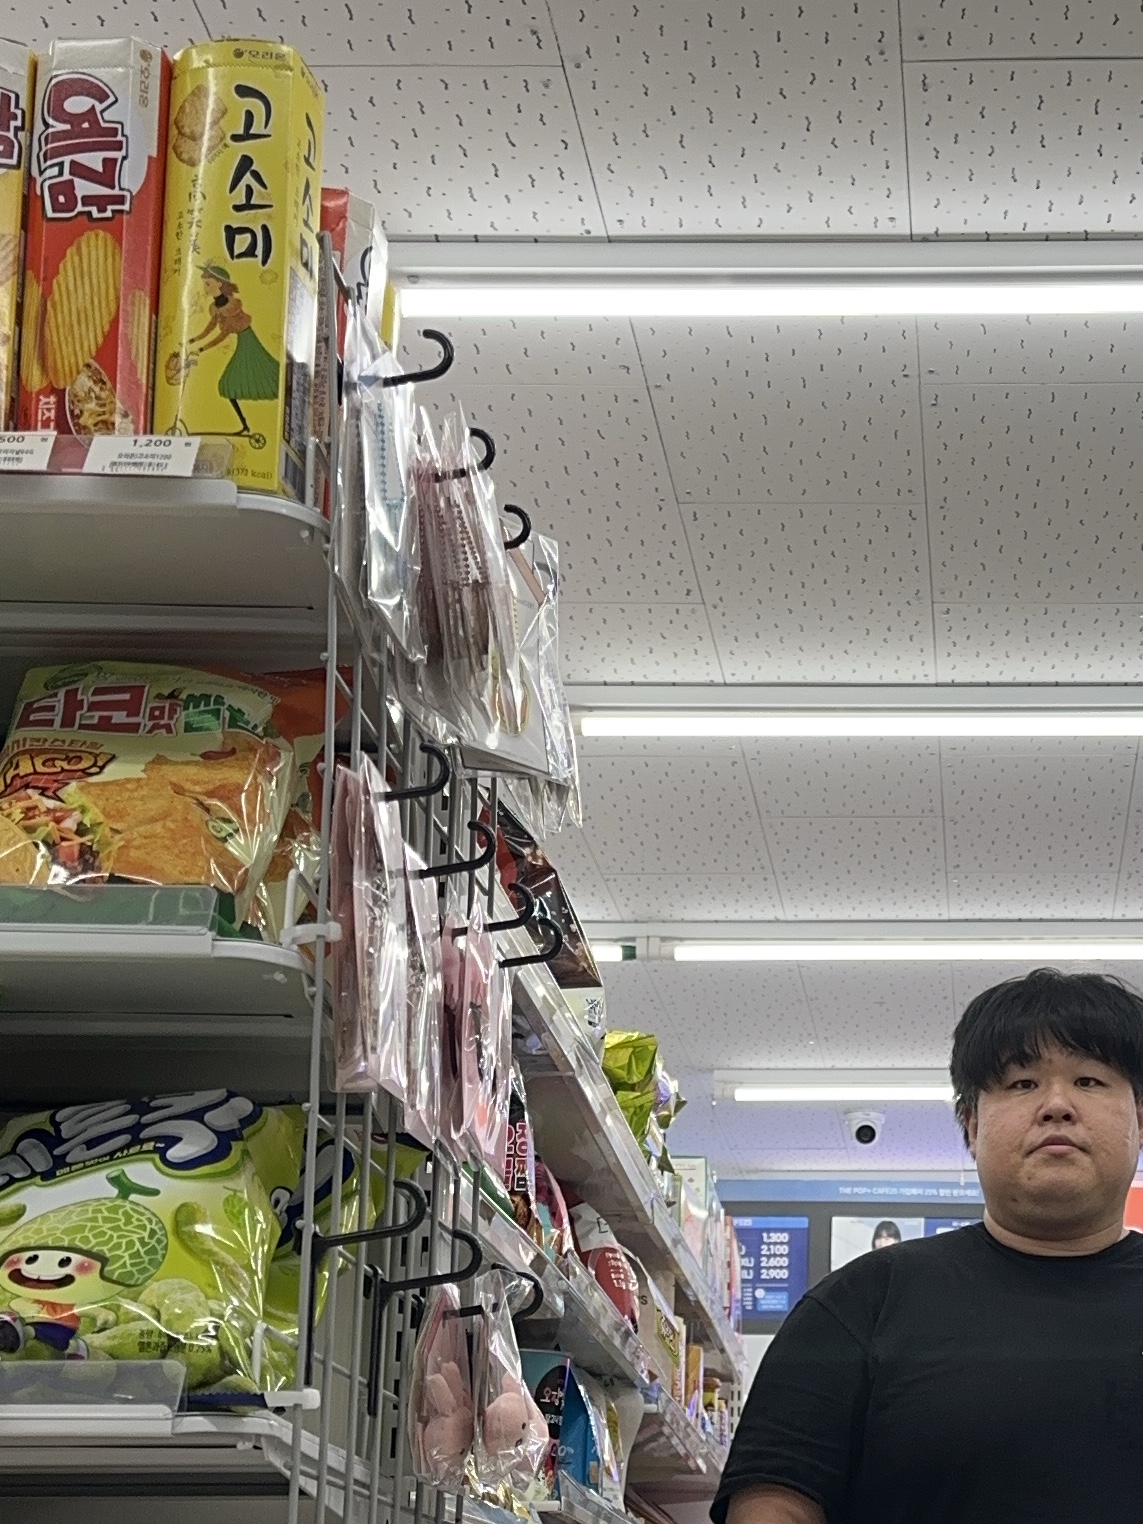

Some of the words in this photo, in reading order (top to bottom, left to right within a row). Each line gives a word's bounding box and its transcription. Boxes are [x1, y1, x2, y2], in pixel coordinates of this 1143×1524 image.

[39, 72, 131, 221] 예감
[223, 82, 275, 268] 고소미
[132, 438, 172, 448] 1,200
[14, 684, 178, 736] 타코맛
[0, 753, 116, 788] ACO!
